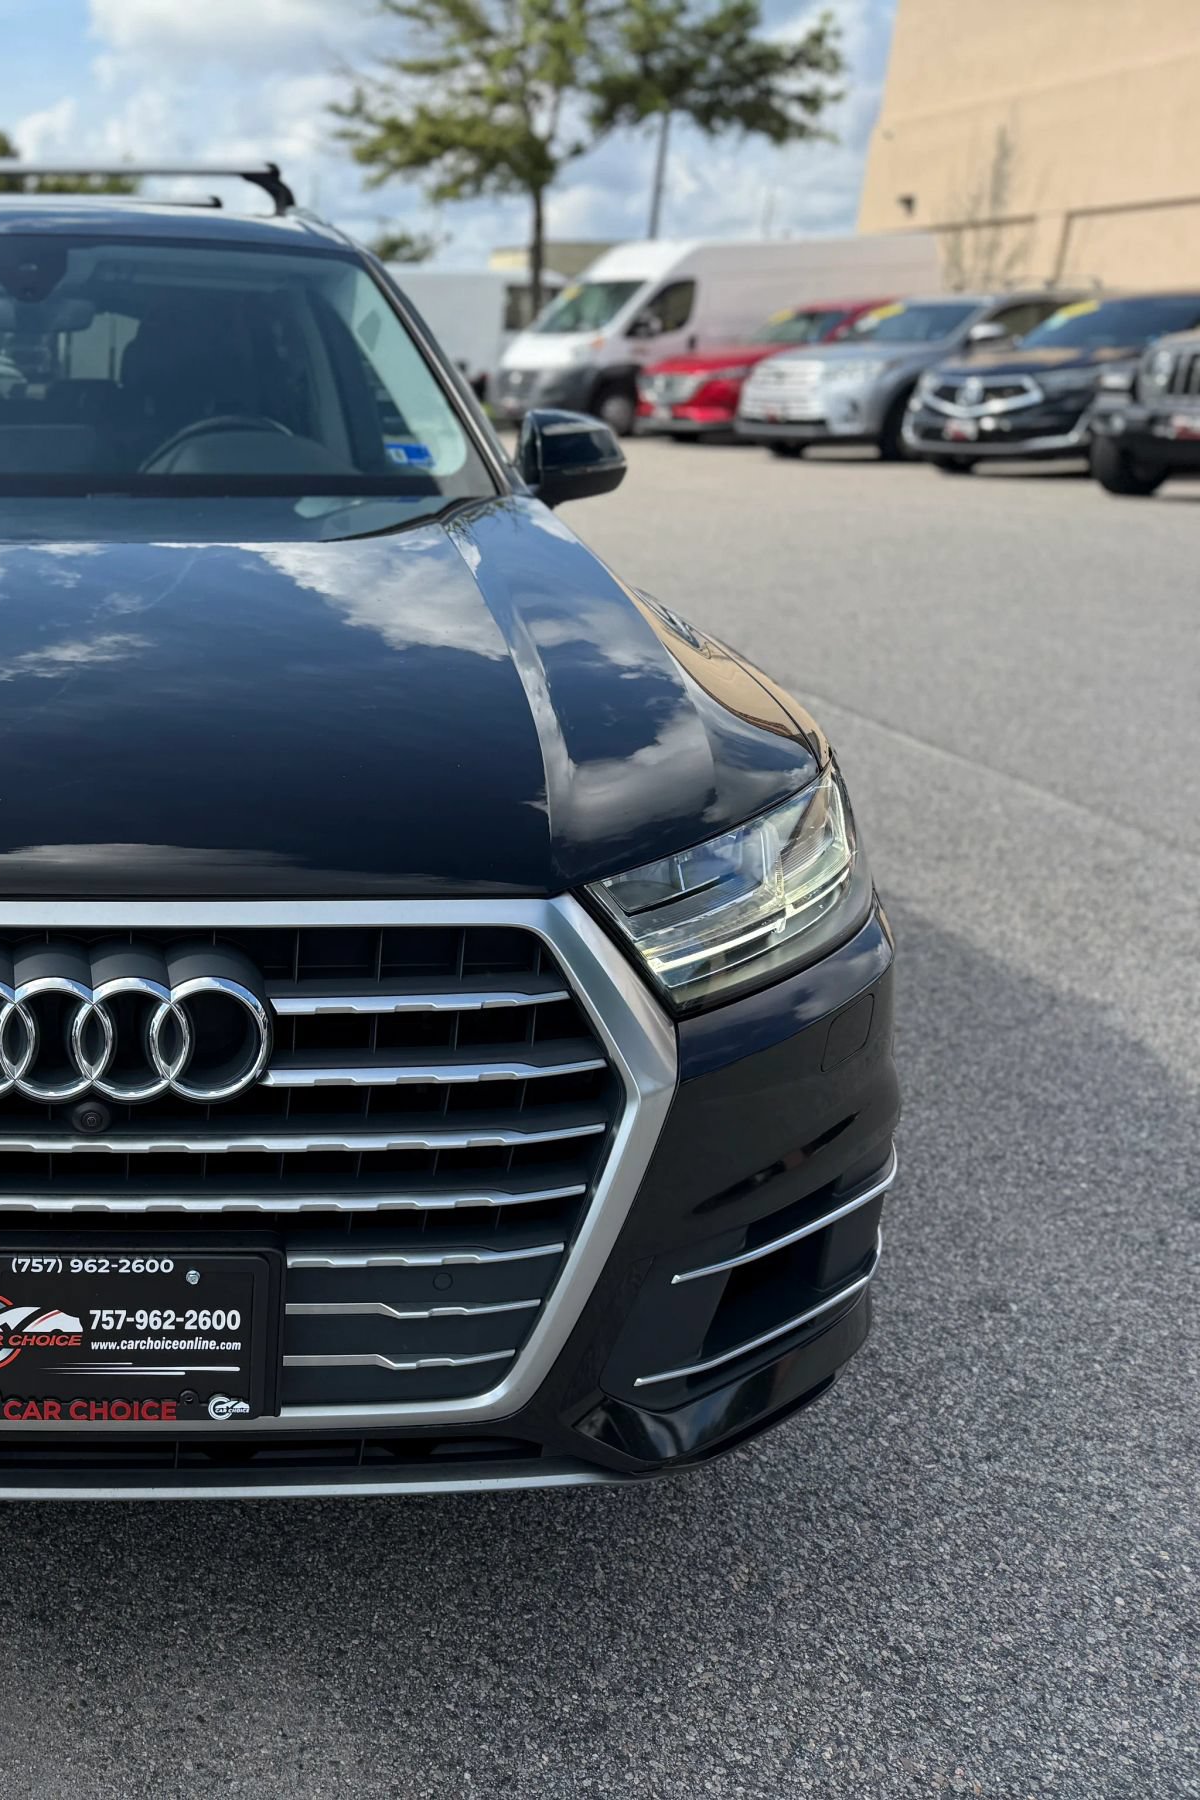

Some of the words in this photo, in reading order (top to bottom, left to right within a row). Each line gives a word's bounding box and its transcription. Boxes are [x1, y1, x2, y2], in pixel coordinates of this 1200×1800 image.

[11, 1257, 63, 1274] (757)
[70, 1258, 174, 1273] 962-2600
[89, 1309, 241, 1330] 757-962-2600
[8, 1335, 82, 1346] CHOICE
[90, 1337, 242, 1350] www.carchoiceonline.com
[3, 1400, 81, 1420] CAR
[88, 1400, 177, 1420] CHOICE
